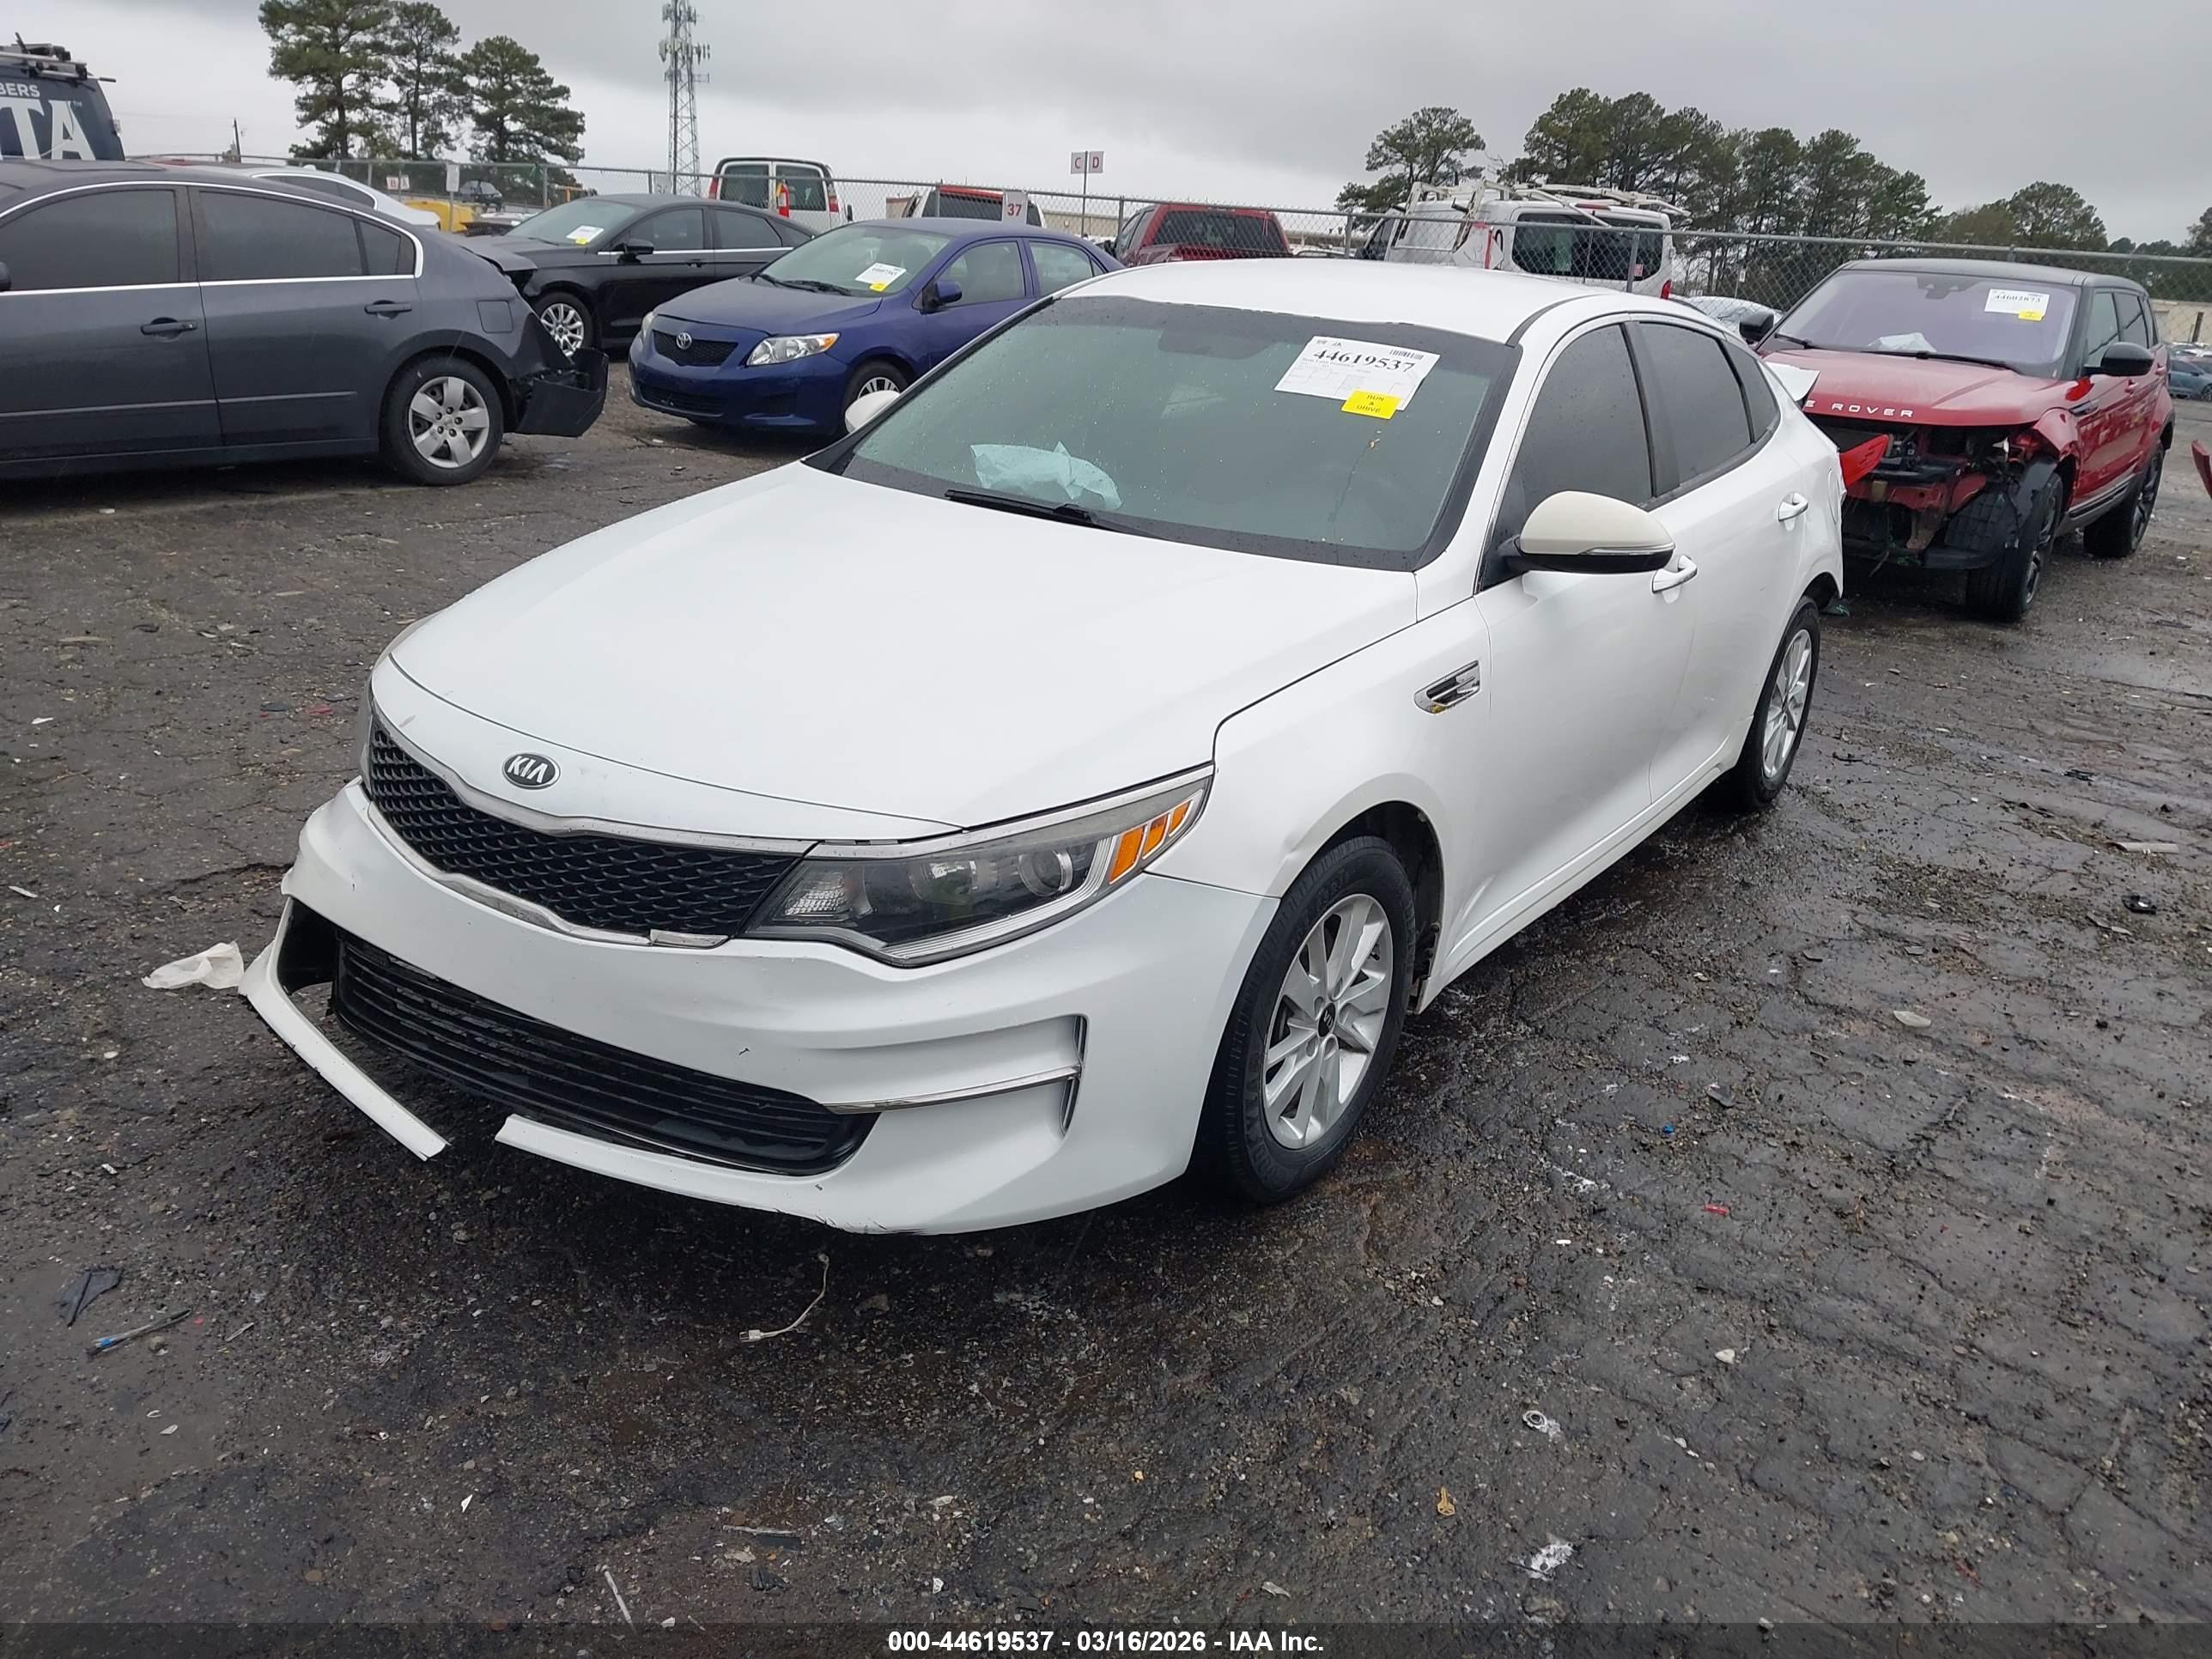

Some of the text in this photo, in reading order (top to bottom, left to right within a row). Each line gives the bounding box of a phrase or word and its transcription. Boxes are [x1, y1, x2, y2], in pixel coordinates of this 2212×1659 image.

[1075, 157, 1082, 169] C
[1092, 156, 1100, 169] D
[1007, 203, 1022, 216] 37
[1313, 349, 1417, 374] 44619537
[1831, 402, 1914, 418] ROVER
[507, 755, 549, 784] KIA
